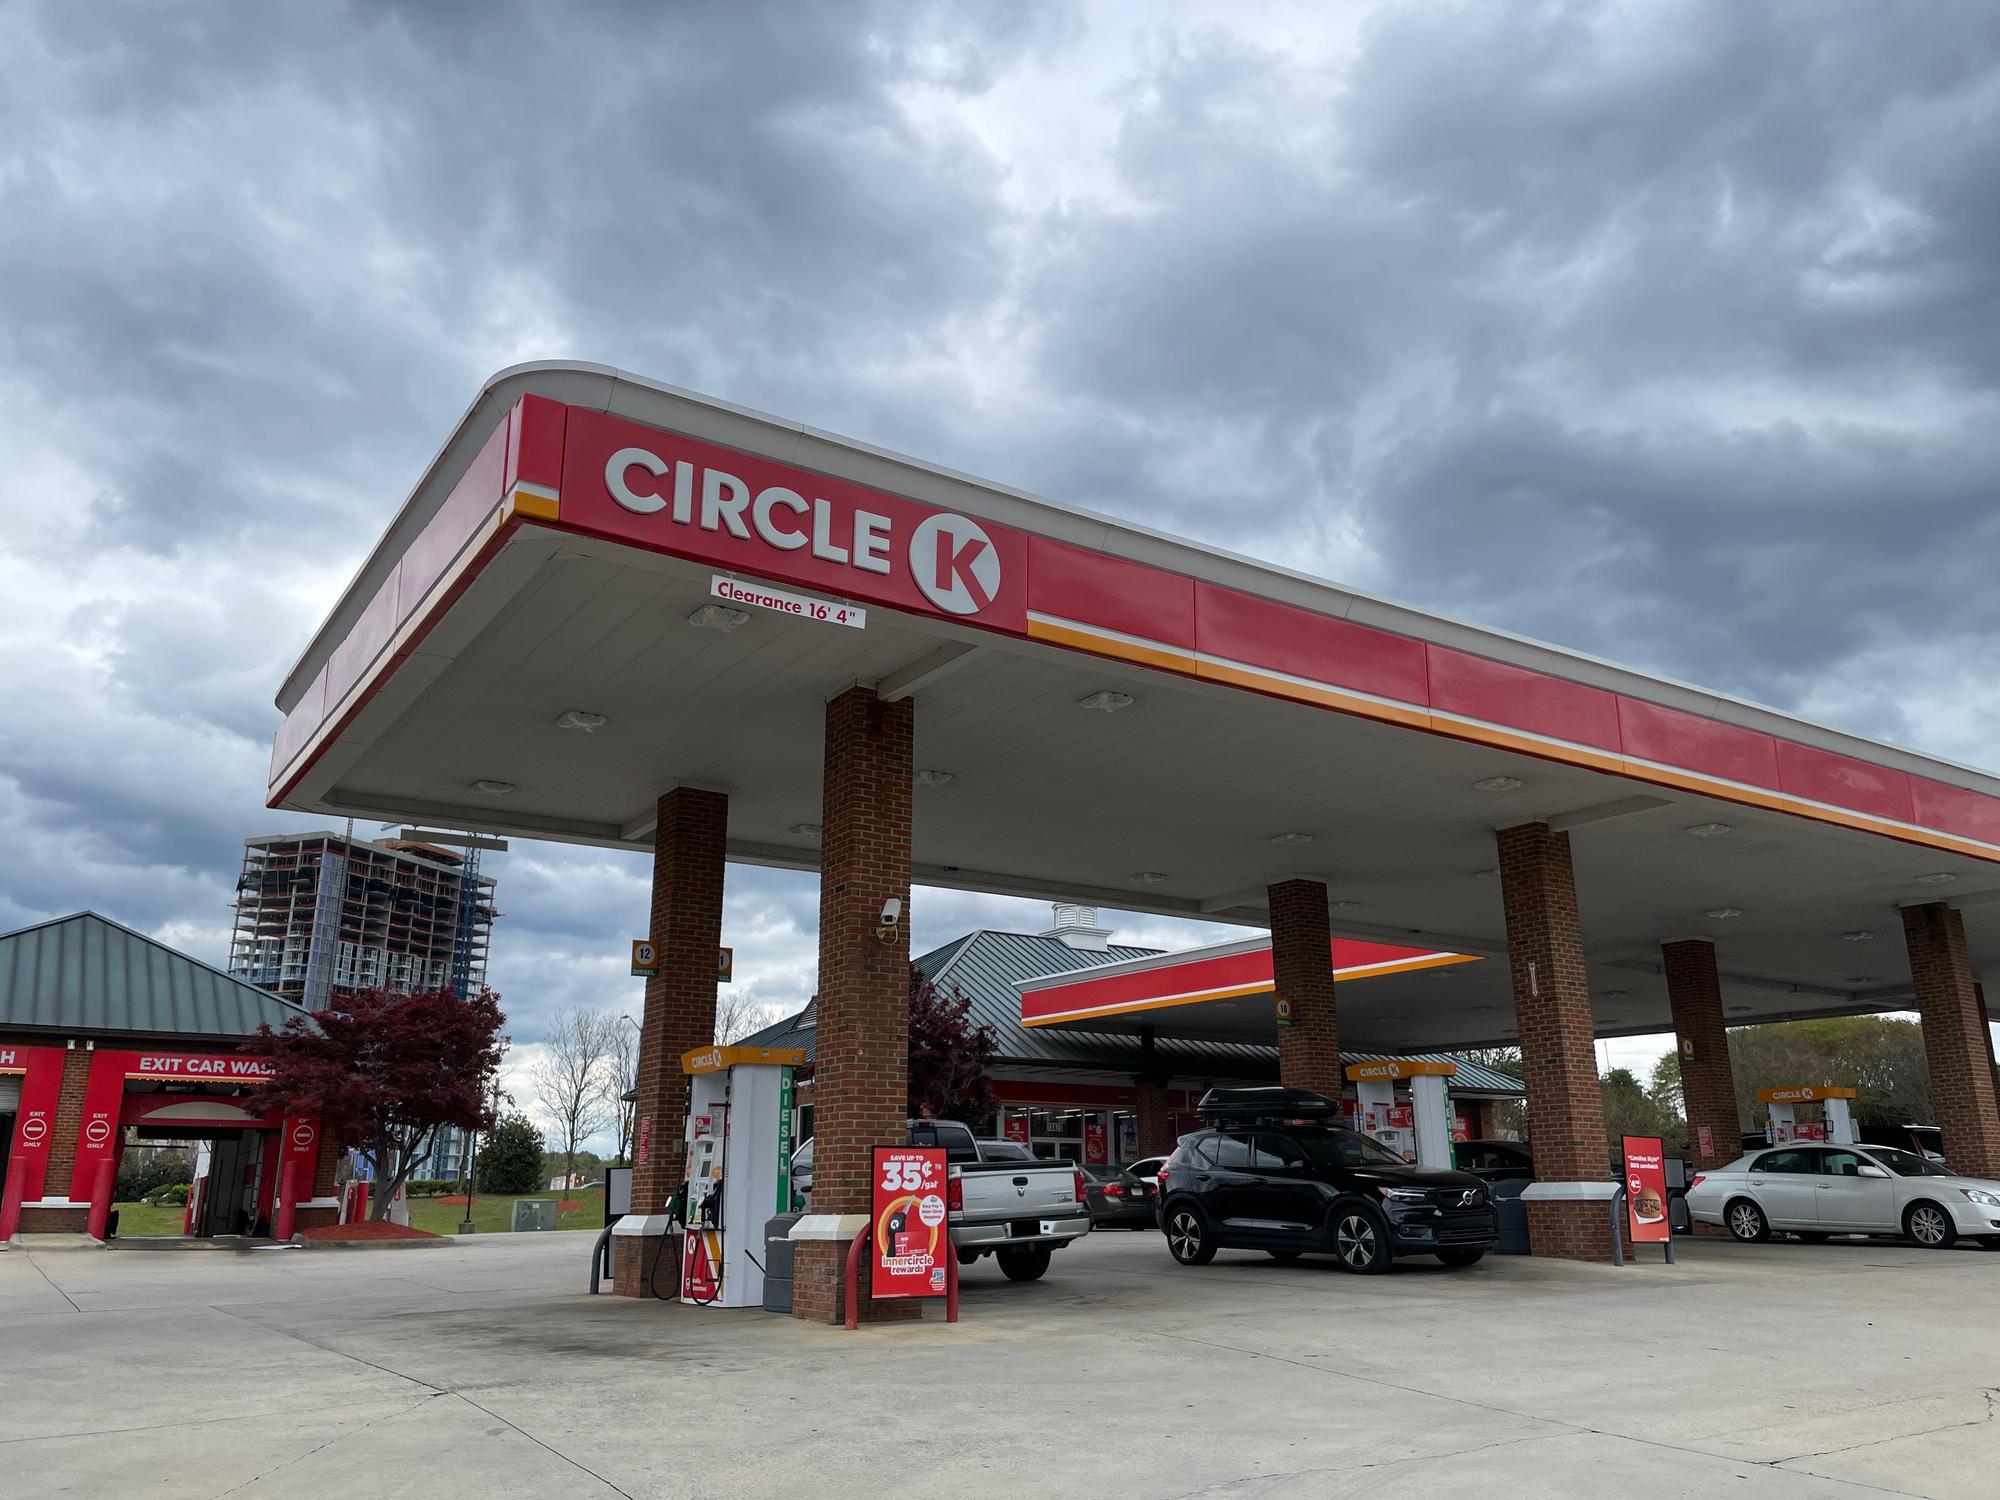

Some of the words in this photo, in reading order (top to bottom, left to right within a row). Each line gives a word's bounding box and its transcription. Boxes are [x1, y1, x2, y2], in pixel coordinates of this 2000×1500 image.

[604, 447, 892, 575] CIRCLE
[928, 522, 995, 613] K
[717, 581, 802, 614] Clearance
[809, 602, 831, 620] 16'
[836, 609, 856, 624] 4"
[639, 948, 651, 960] 12
[139, 1057, 183, 1072] EXIT
[186, 1058, 226, 1074] CAR
[230, 1060, 277, 1075] WAS
[692, 1056, 713, 1068] CIRCLE
[1360, 1067, 1389, 1077] CIRCLE
[1389, 1063, 1400, 1077] K
[1772, 1090, 1801, 1099] CIRCLE
[1802, 1088, 1813, 1099] K
[780, 1078, 791, 1173] DIESEL
[1443, 1084, 1455, 1154] DIESEL
[881, 1160, 933, 1191] 35¢
[882, 1255, 933, 1266] innercircle
[892, 1265, 924, 1274] rewards
